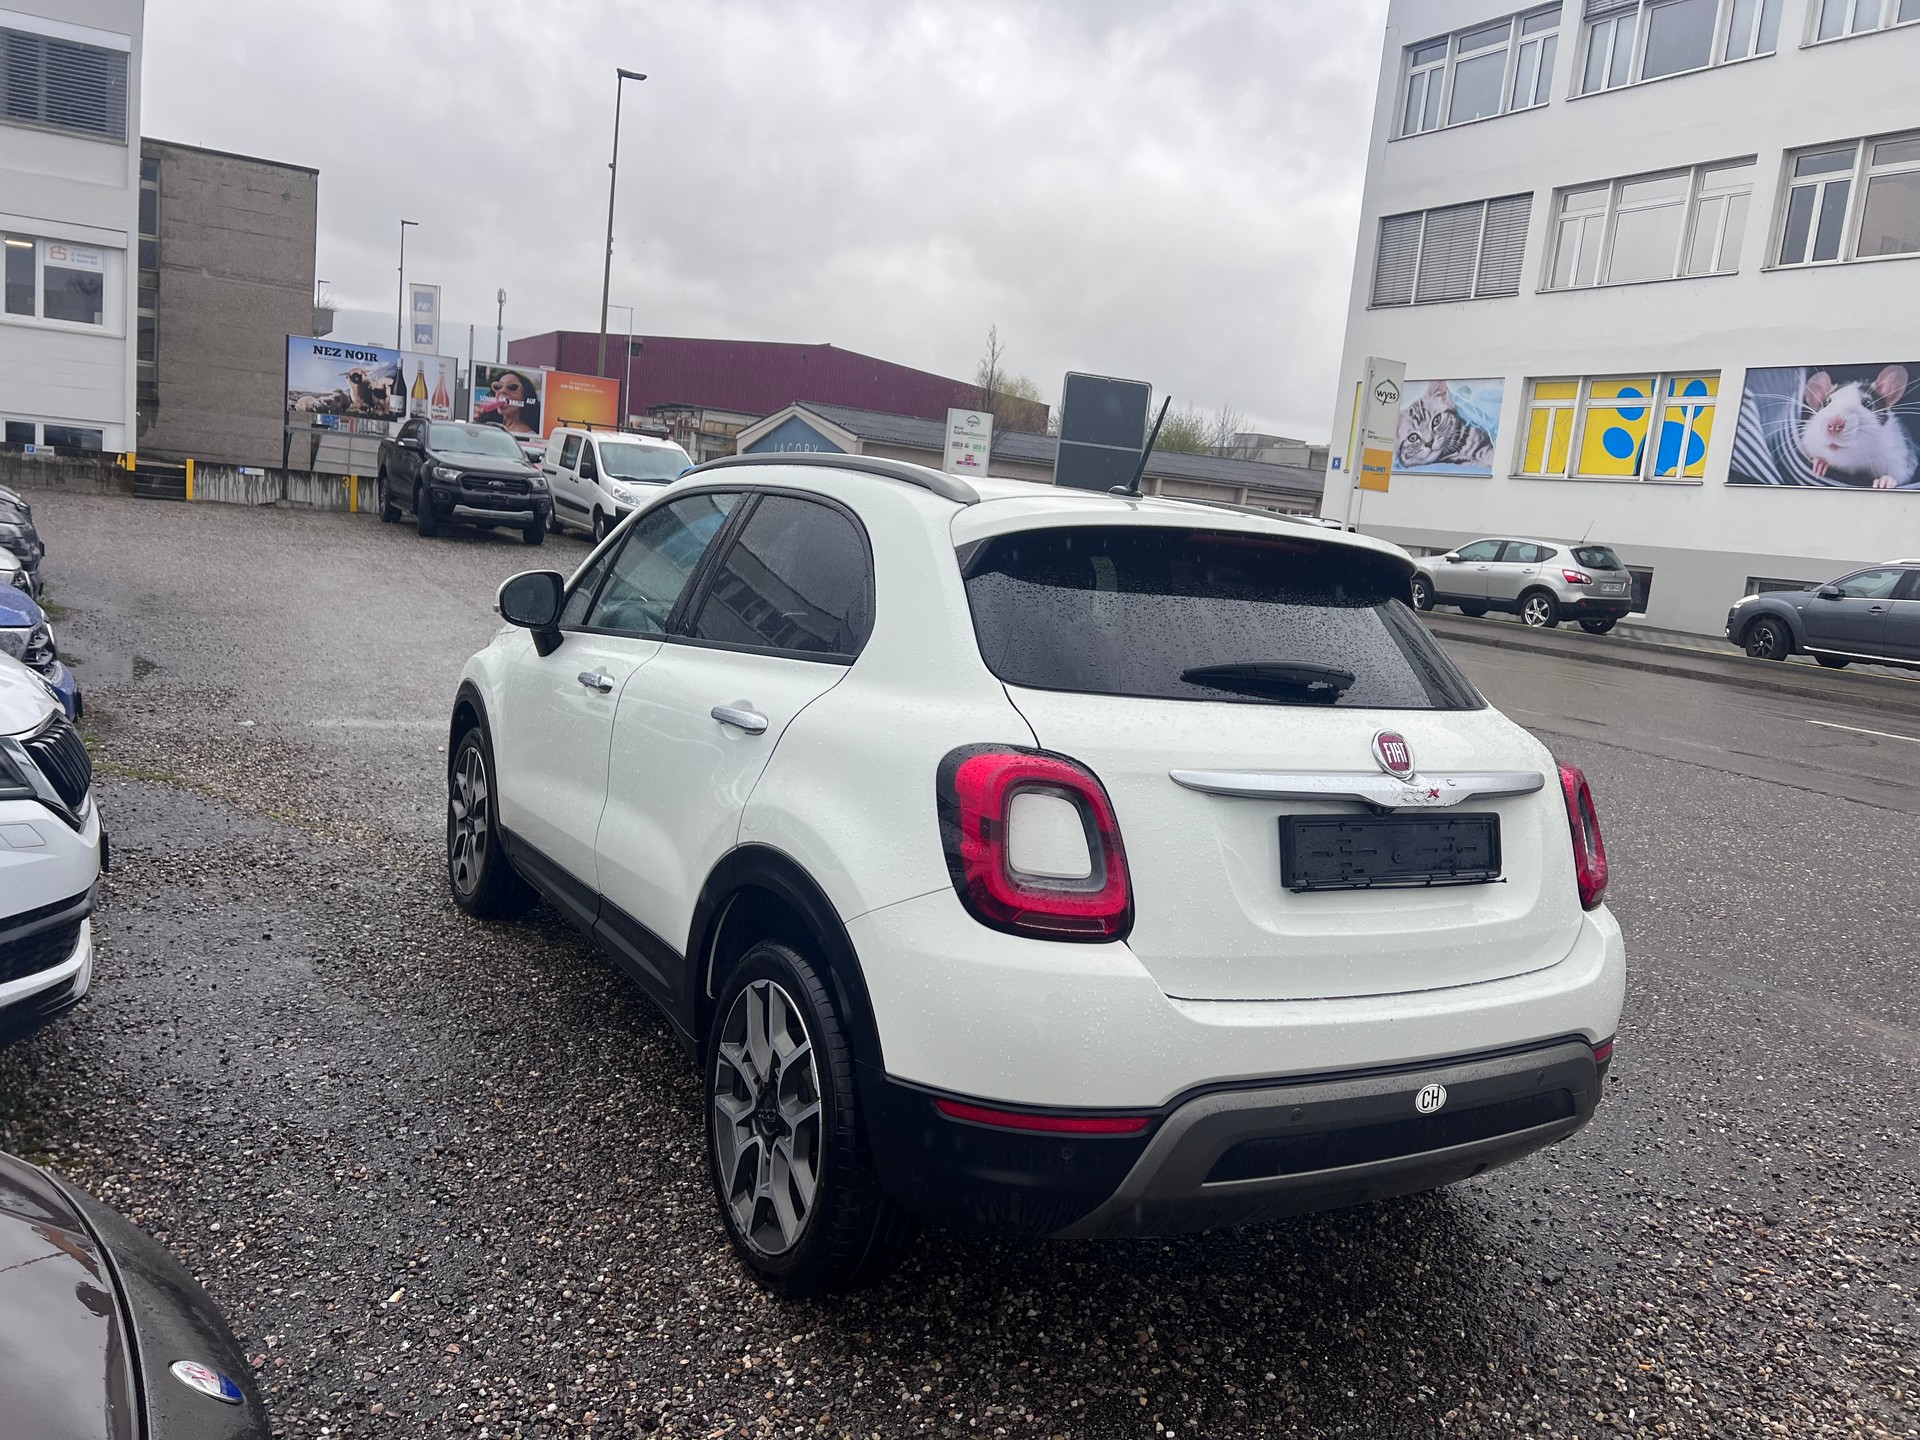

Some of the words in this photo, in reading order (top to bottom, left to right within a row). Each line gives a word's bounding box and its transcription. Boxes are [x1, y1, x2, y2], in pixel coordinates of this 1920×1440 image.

[313, 345, 341, 357] NEZ
[345, 349, 378, 362] NOIR
[1376, 389, 1396, 406] wyss
[1334, 460, 1339, 468] 8
[341, 476, 350, 489] 3
[1382, 742, 1408, 763] FIAT
[1422, 1089, 1440, 1109] CH
